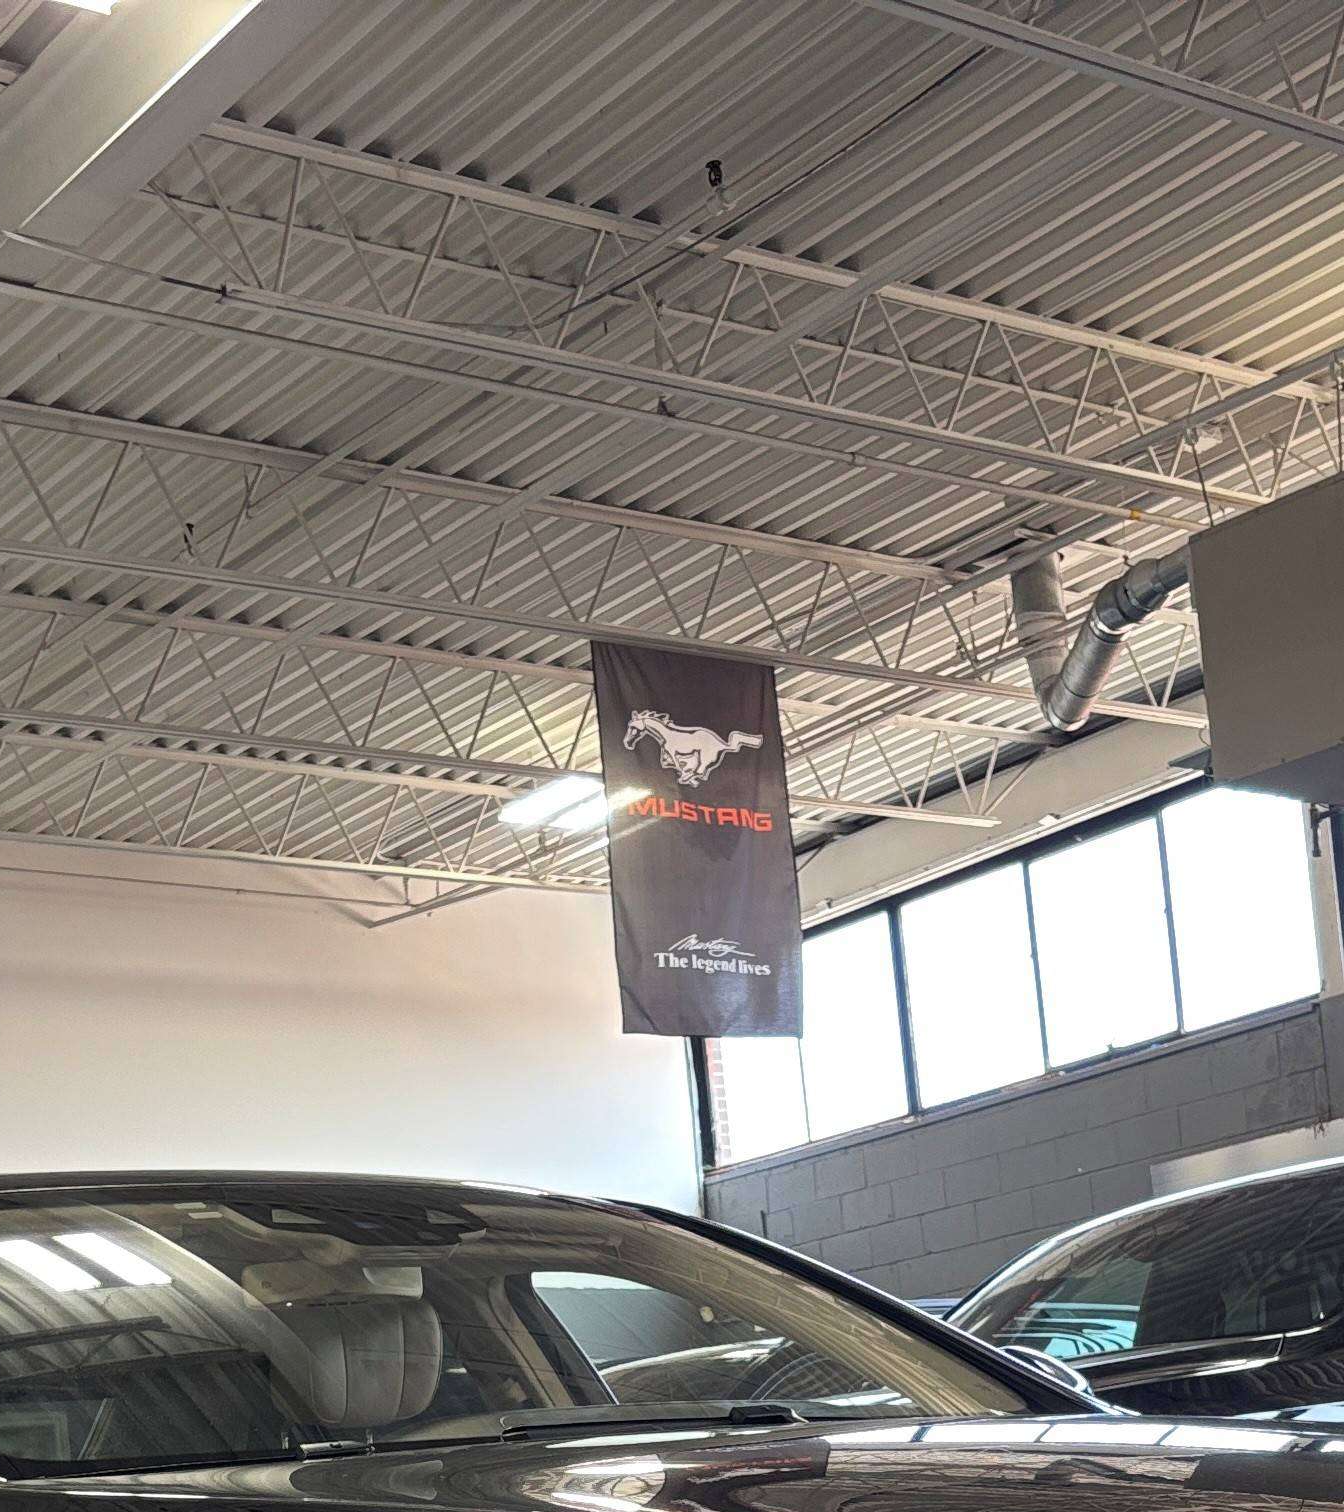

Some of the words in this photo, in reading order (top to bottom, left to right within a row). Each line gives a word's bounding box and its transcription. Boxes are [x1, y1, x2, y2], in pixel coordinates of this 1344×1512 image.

[627, 797, 773, 832] MUSTANG
[654, 952, 689, 968] The
[691, 954, 736, 974] legend
[738, 959, 772, 976] lives
